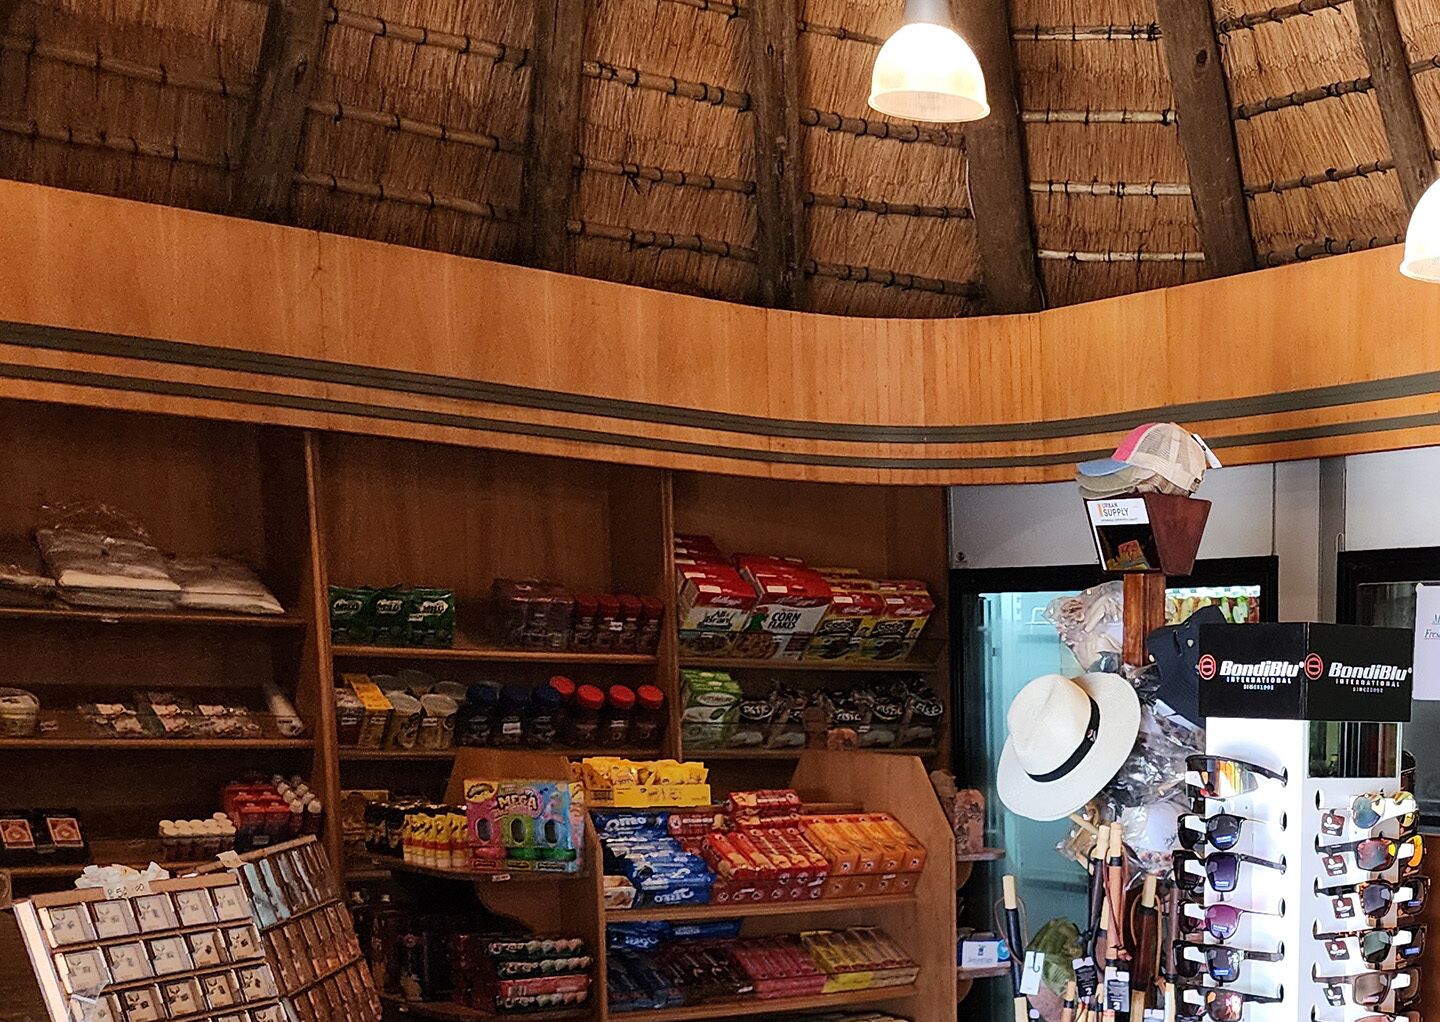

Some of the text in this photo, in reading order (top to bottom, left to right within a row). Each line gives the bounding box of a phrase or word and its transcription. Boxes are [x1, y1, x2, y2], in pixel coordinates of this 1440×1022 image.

[1103, 508, 1129, 517] SUPPLY
[771, 612, 802, 622] CORN
[767, 621, 797, 629] FLAKES
[1219, 660, 1299, 678] BondiBlu
[1328, 662, 1408, 681] BondiBlu
[1226, 676, 1292, 685] INTERNATIONAL
[1335, 678, 1401, 689] INTERNATIONAL
[497, 792, 538, 811] MEGA
